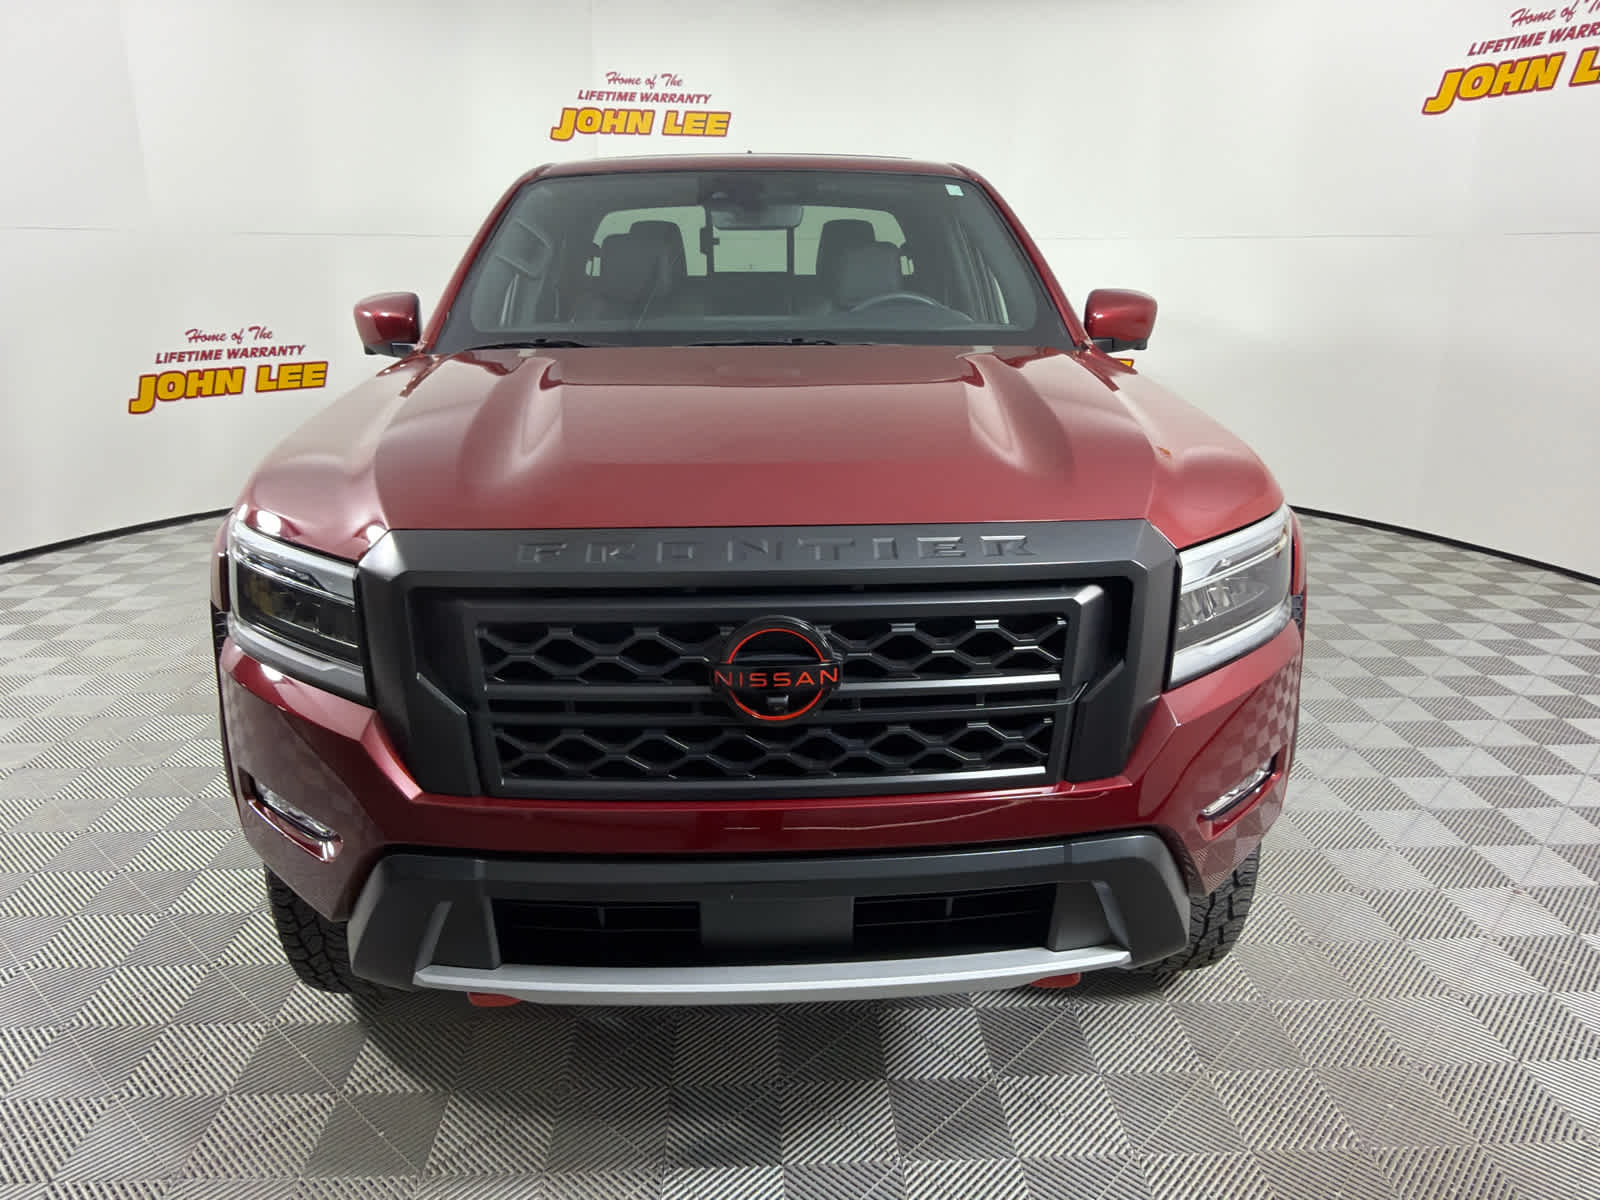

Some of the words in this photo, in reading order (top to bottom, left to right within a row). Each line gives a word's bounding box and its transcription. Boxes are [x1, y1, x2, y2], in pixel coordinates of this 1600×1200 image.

[1510, 8, 1556, 28] Home
[1560, 0, 1580, 22] of
[1467, 31, 1547, 56] LIFETIME
[605, 71, 641, 86] Home
[644, 74, 657, 89] of
[660, 73, 683, 87] The
[1421, 51, 1567, 115] JOHN
[577, 89, 637, 102] LIFETIME
[639, 92, 712, 104] WARRANTY
[550, 107, 656, 142] JOHN
[662, 110, 731, 137] LEE
[185, 328, 227, 344] Home
[231, 328, 244, 344] of
[248, 326, 273, 341] The
[155, 349, 223, 364] LIFETIME
[226, 345, 306, 360] WARRANTY
[128, 366, 246, 414] JOHN
[255, 361, 328, 393] LEE
[516, 535, 1037, 564] FRONTIER
[713, 667, 839, 688] NISSAN
